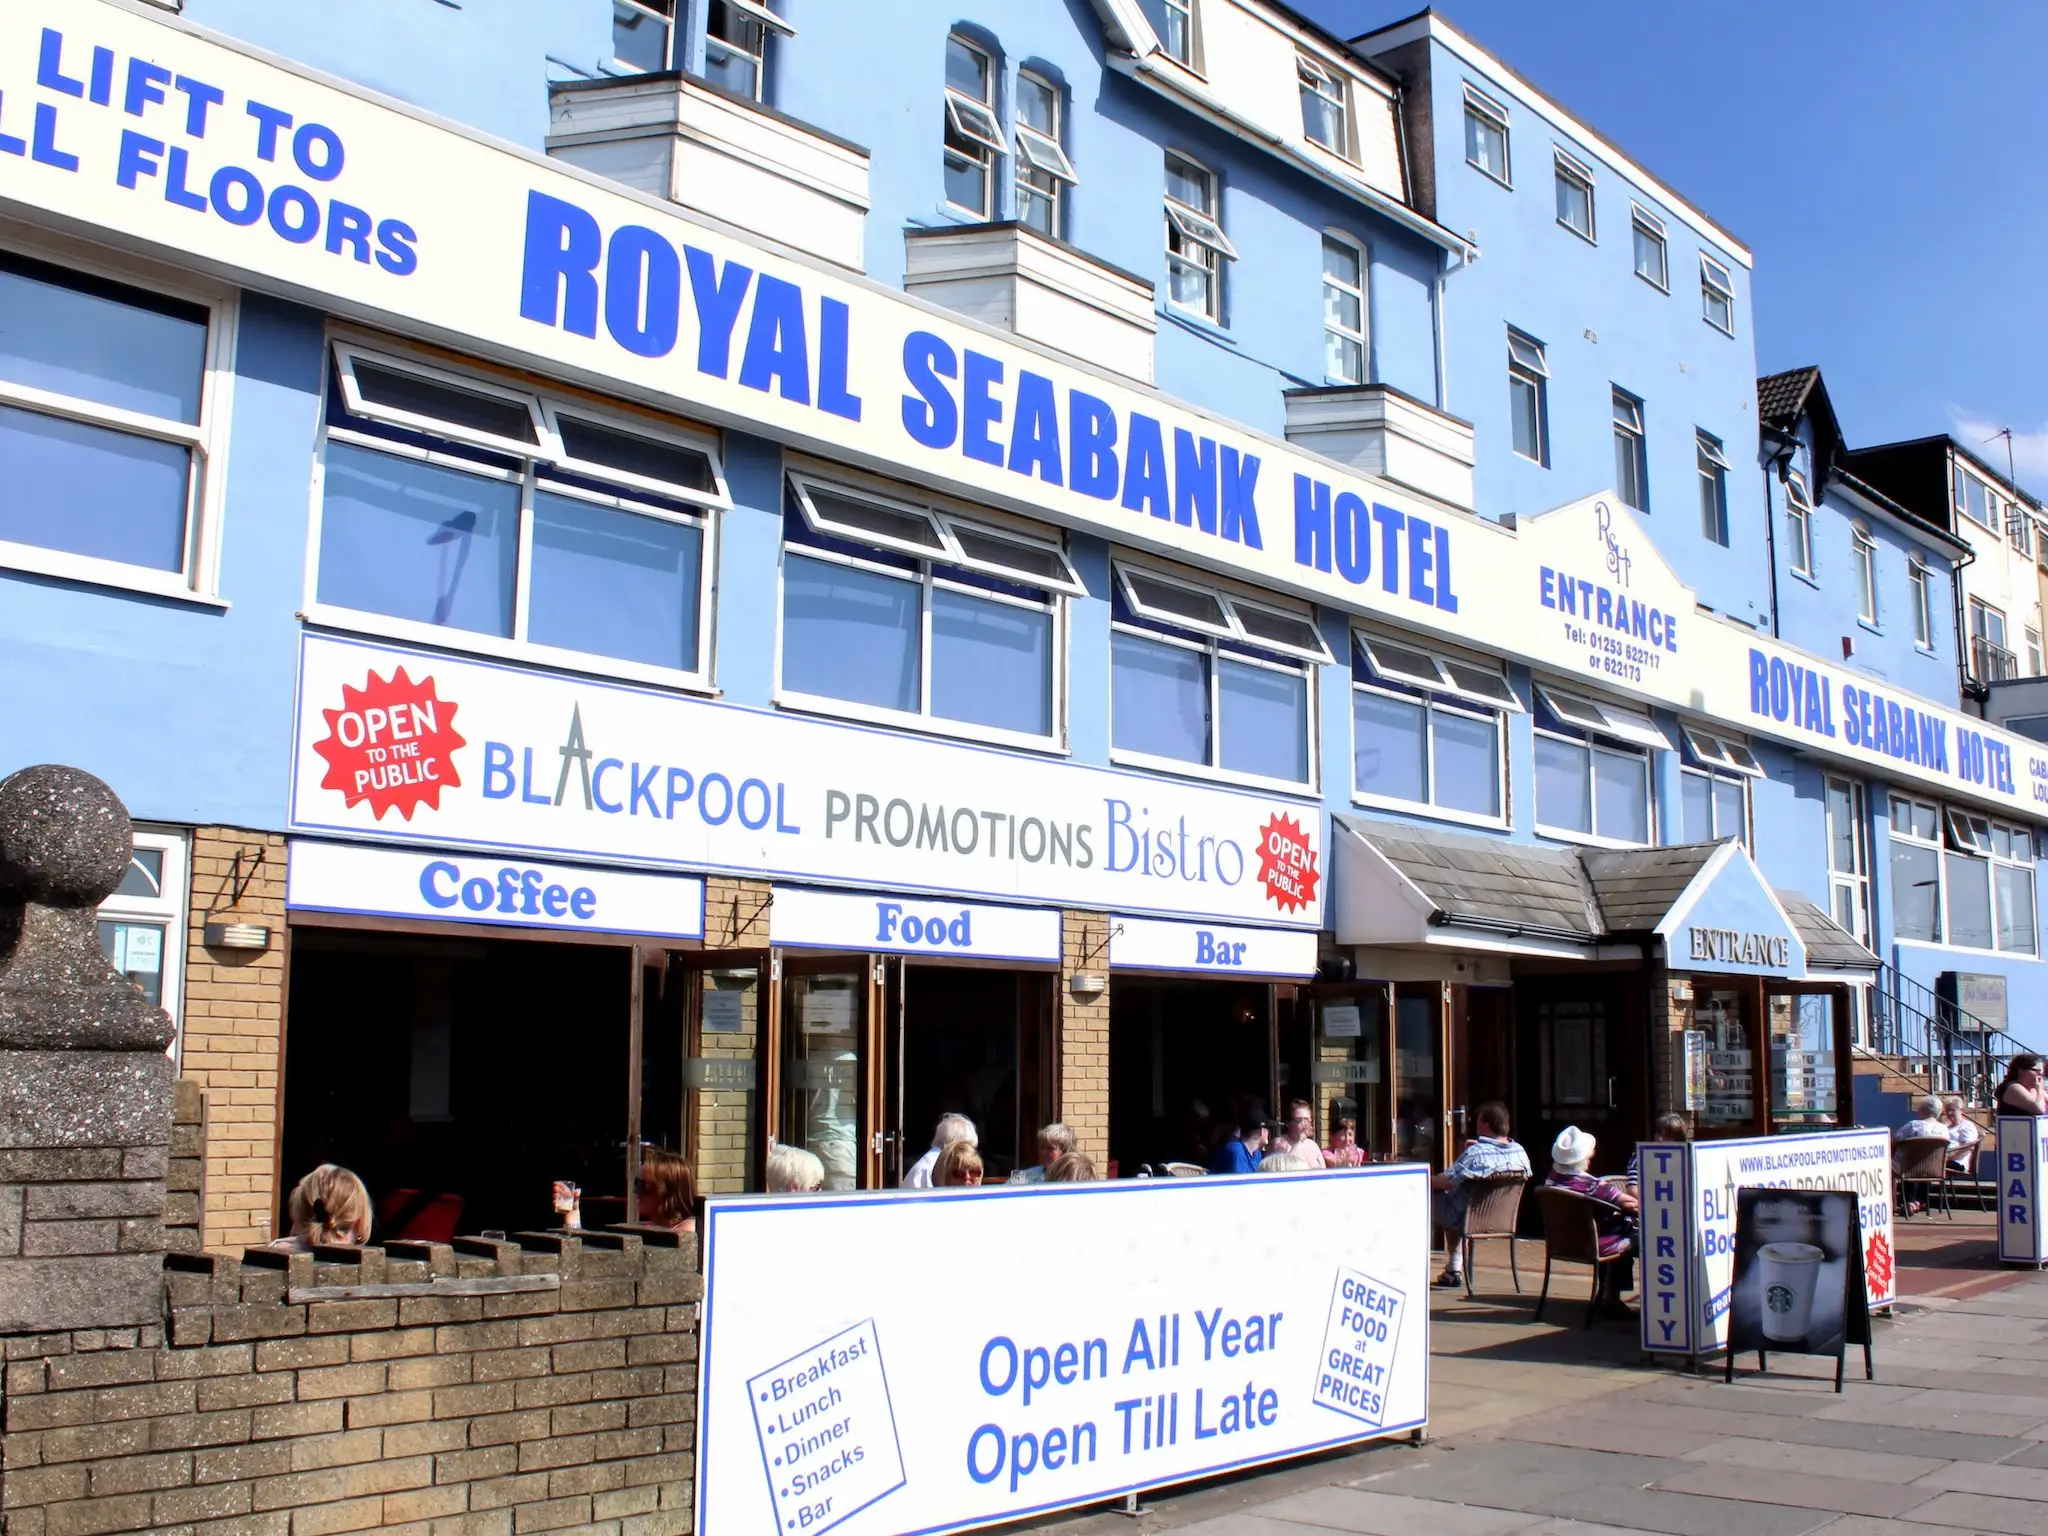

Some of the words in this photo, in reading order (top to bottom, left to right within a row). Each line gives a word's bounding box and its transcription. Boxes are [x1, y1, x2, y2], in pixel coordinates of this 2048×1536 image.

[37, 27, 223, 138] LIFT
[246, 100, 344, 181] TO
[116, 129, 417, 275] FLOORS
[520, 189, 861, 423] ROYAL
[901, 331, 1263, 551] SEABANK
[1294, 473, 1458, 614] HOTEL
[1540, 565, 1677, 653] ENTRANCE
[1564, 623, 1586, 644] Tel:
[1590, 632, 1622, 656] 01253
[1625, 643, 1660, 669] 622717
[1589, 655, 1600, 668] or
[1604, 657, 1641, 682] 622173
[337, 700, 438, 748] OPEN
[1749, 647, 1835, 738] ROYAL
[1843, 684, 1949, 774] SEABANK
[1956, 726, 2016, 795] HOTEL
[354, 757, 439, 793] PUBLIC
[365, 747, 387, 764] TO
[389, 742, 420, 760] THE
[482, 699, 801, 834] BLACKPOOL
[826, 789, 1093, 869] PROMOTIONS
[1103, 797, 1244, 887] Bistro
[1268, 831, 1312, 873] OPEN
[1277, 860, 1286, 872] TO
[1287, 865, 1300, 880] THE
[419, 860, 597, 920] Coffee
[1267, 868, 1304, 900] PUBLIC
[876, 902, 972, 948] Food
[1688, 927, 1790, 967] ENTRANCE
[1195, 931, 1246, 966] Bar
[1739, 1145, 1885, 1173] WWW.BLACKPOOLPROMOTIONS.COM
[2007, 1152, 2028, 1224] BAR
[1654, 1152, 1677, 1342] THIRSTY
[1342, 1278, 1398, 1318] GREAT
[1340, 1306, 1388, 1343] FOOD
[1354, 1339, 1367, 1353] at
[771, 1336, 868, 1402] Breakfast
[980, 1335, 1108, 1406] Open
[1122, 1312, 1179, 1375] All
[1195, 1307, 1283, 1361] Year
[1328, 1348, 1385, 1386] GREAT
[778, 1386, 842, 1434] Lunch
[1319, 1373, 1381, 1415] PRICES
[785, 1416, 851, 1465] Dinner
[966, 1418, 1097, 1492] Open
[1114, 1391, 1178, 1455] Till
[1195, 1380, 1279, 1440] Late
[792, 1445, 865, 1497] Snacks
[798, 1496, 833, 1528] Bar
